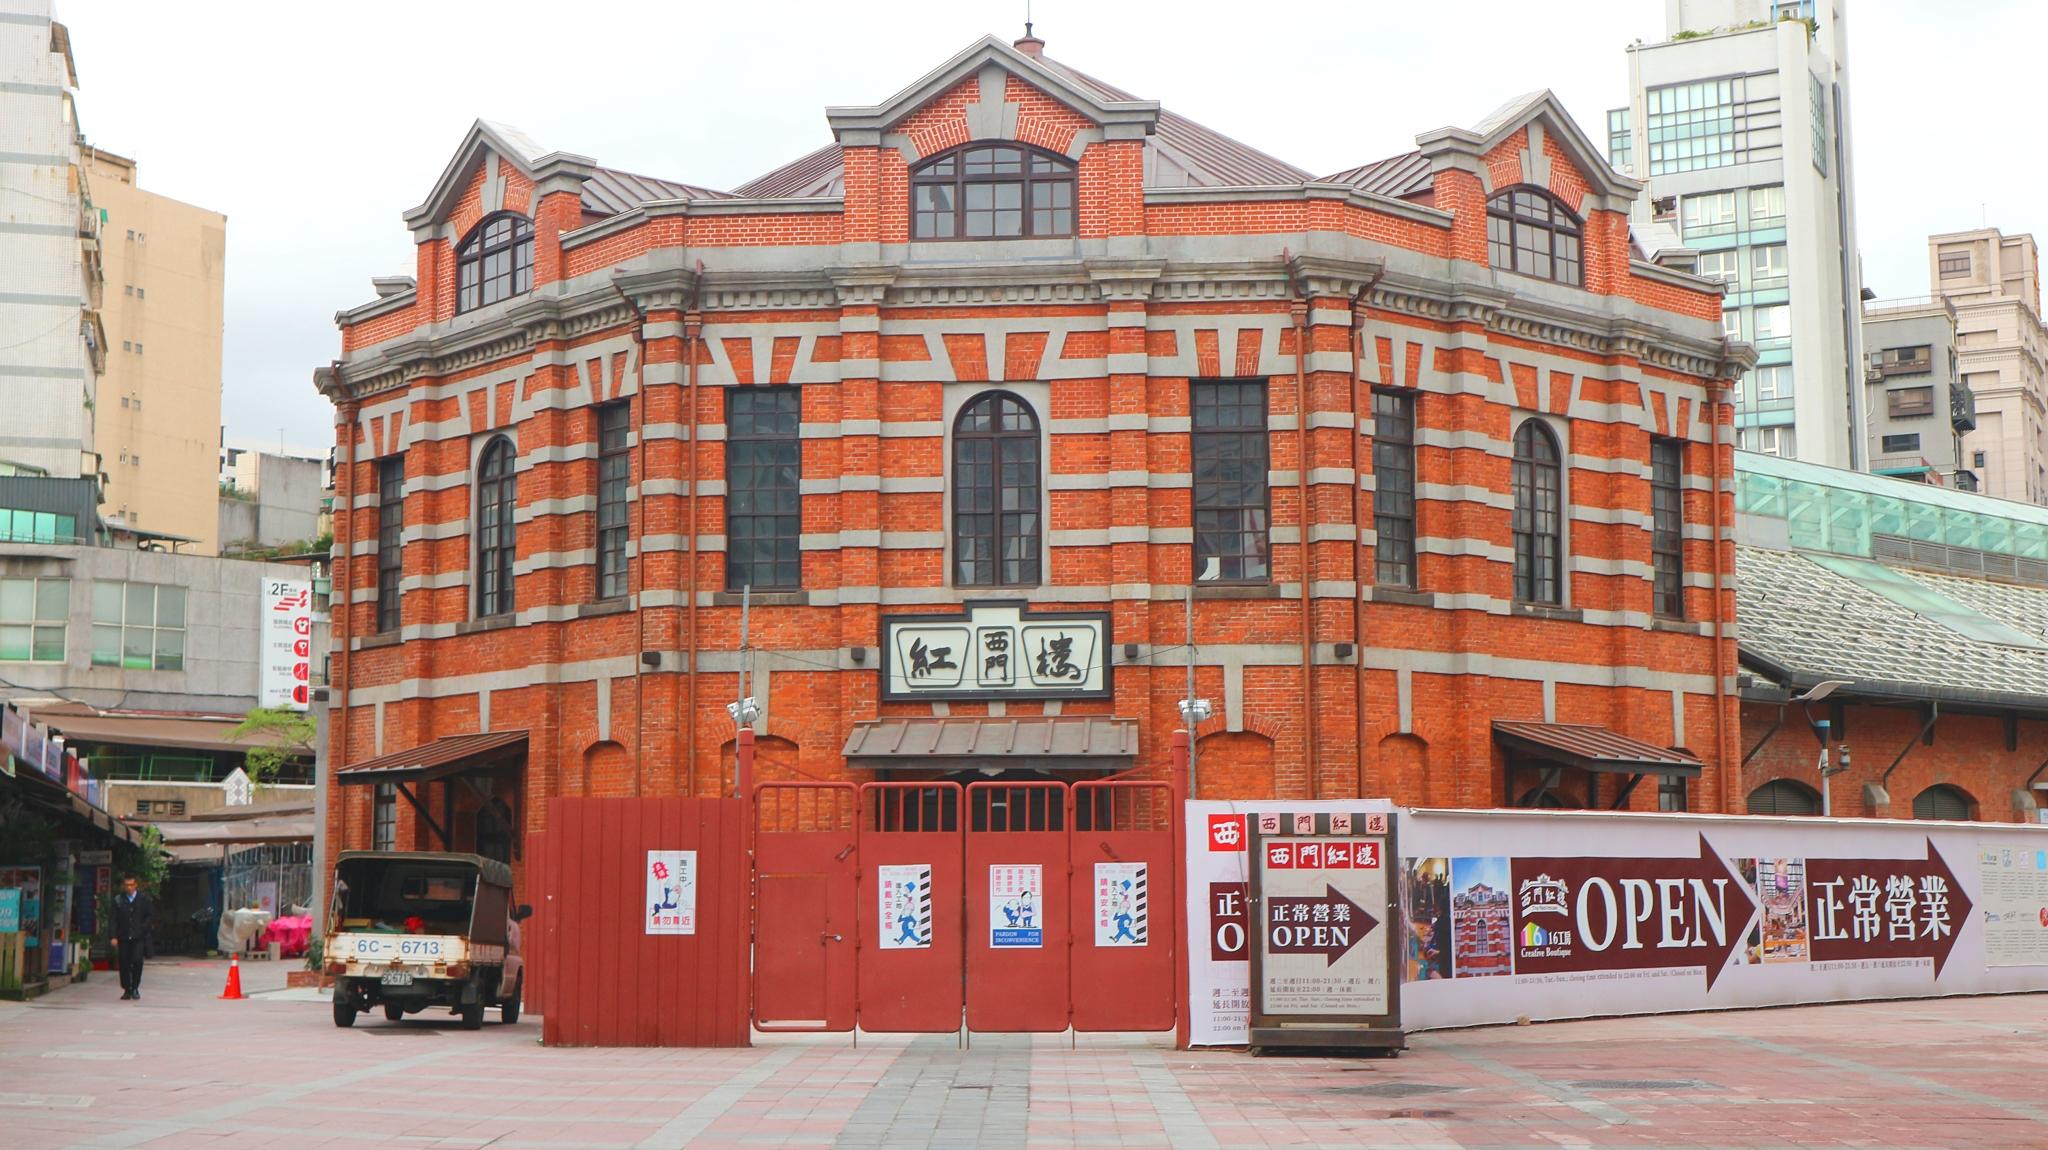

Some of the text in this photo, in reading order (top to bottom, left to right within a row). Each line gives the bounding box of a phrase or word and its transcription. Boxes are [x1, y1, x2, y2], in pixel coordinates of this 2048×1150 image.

[272, 583, 288, 596] 2F
[910, 637, 957, 678] 紅
[983, 631, 1008, 681] 西門
[1272, 904, 1351, 922] 正常營業
[1576, 876, 1728, 951] OPEN
[1812, 874, 1951, 942] 正常營業
[1272, 926, 1351, 947] OPEN
